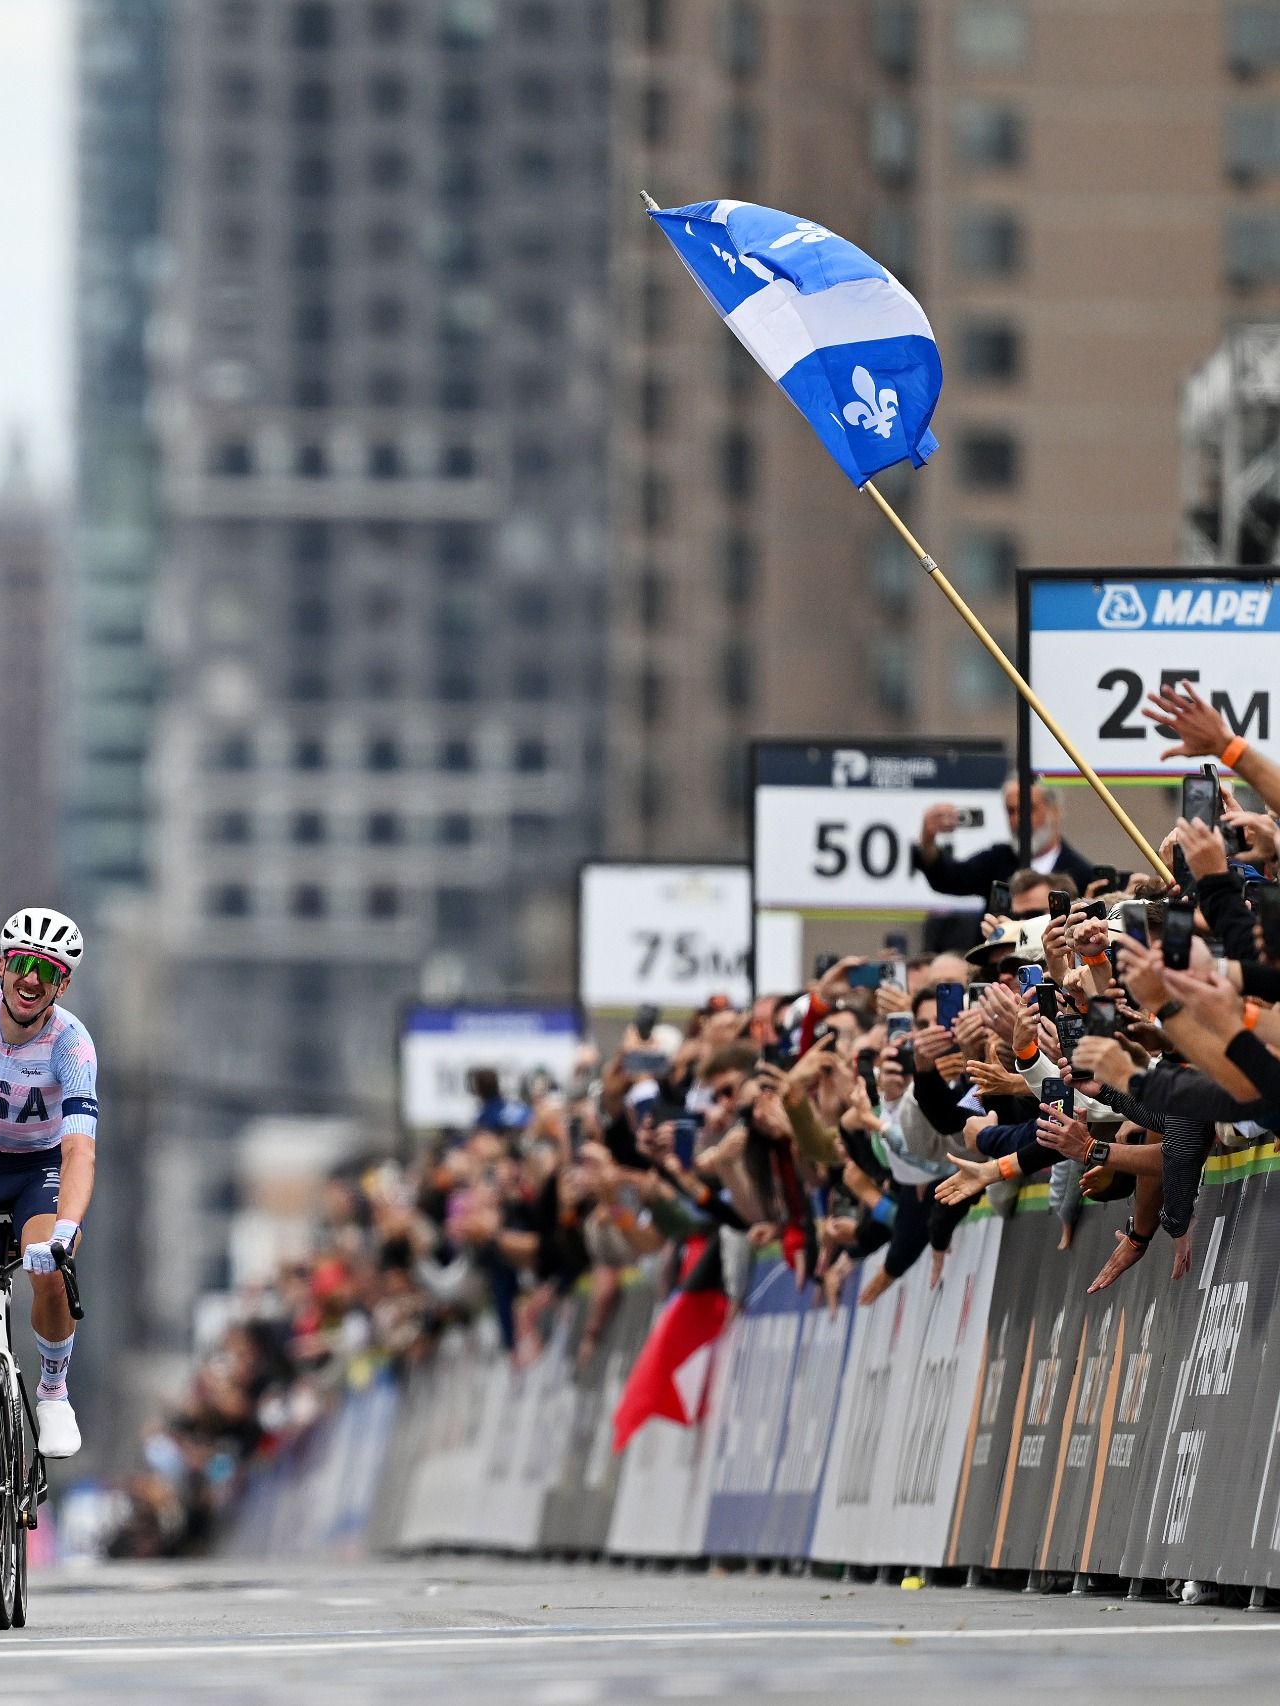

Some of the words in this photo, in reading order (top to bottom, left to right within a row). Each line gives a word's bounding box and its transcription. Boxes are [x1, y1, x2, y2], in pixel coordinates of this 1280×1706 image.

[1152, 590, 1273, 626] MAPEI
[21, 1067, 43, 1078] Rapha
[1162, 1430, 1208, 1545] TECH
